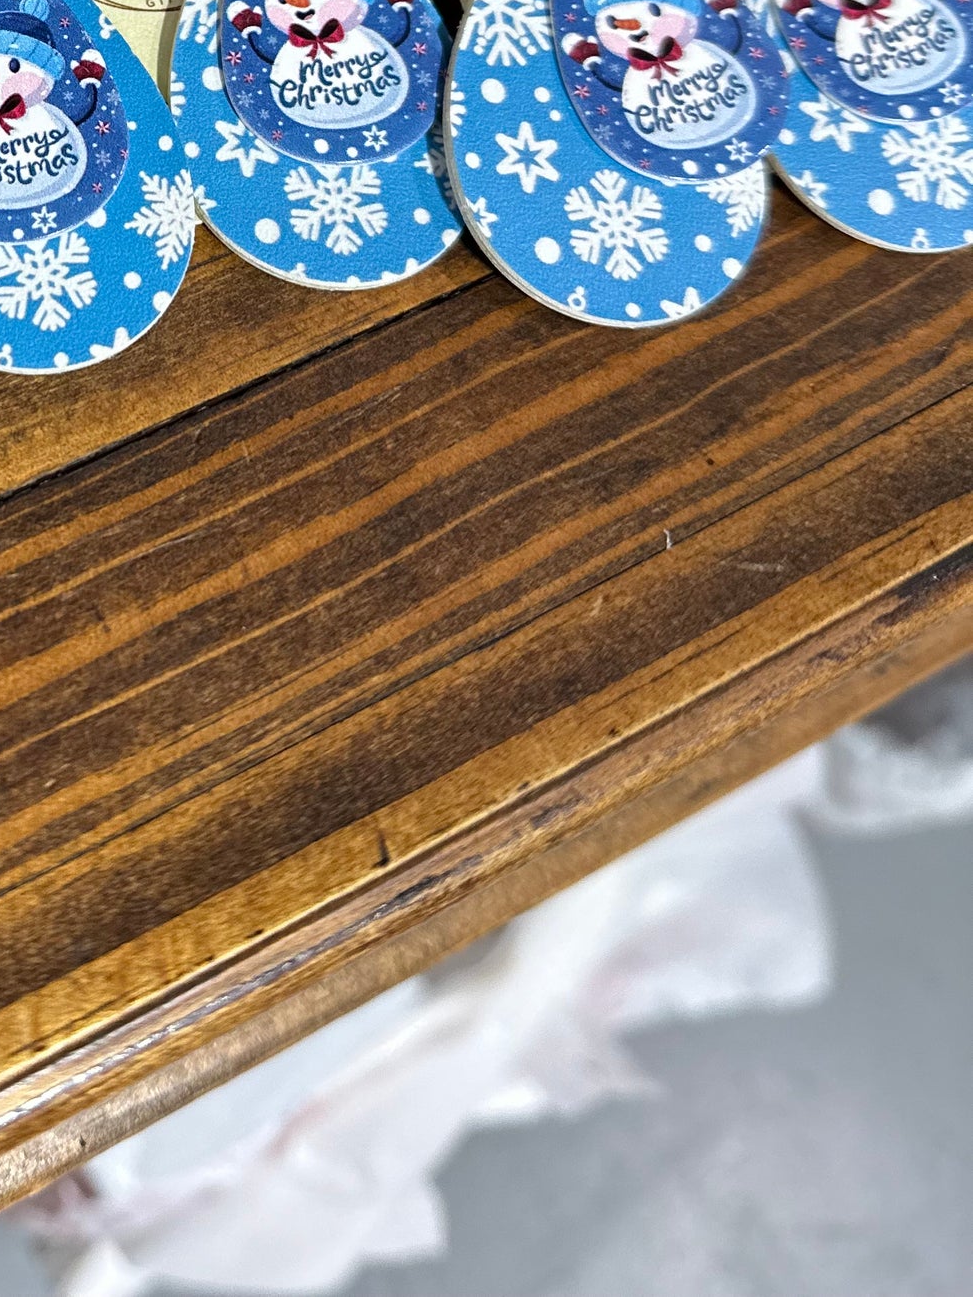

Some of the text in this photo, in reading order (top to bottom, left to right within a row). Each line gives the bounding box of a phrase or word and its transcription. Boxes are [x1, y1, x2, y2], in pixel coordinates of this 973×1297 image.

[837, 18, 957, 82] Christmas
[860, 5, 937, 54] Merry
[270, 65, 401, 110] Christmas
[299, 49, 389, 86] Merry
[648, 58, 730, 106] Merry
[623, 73, 748, 135] Christmas
